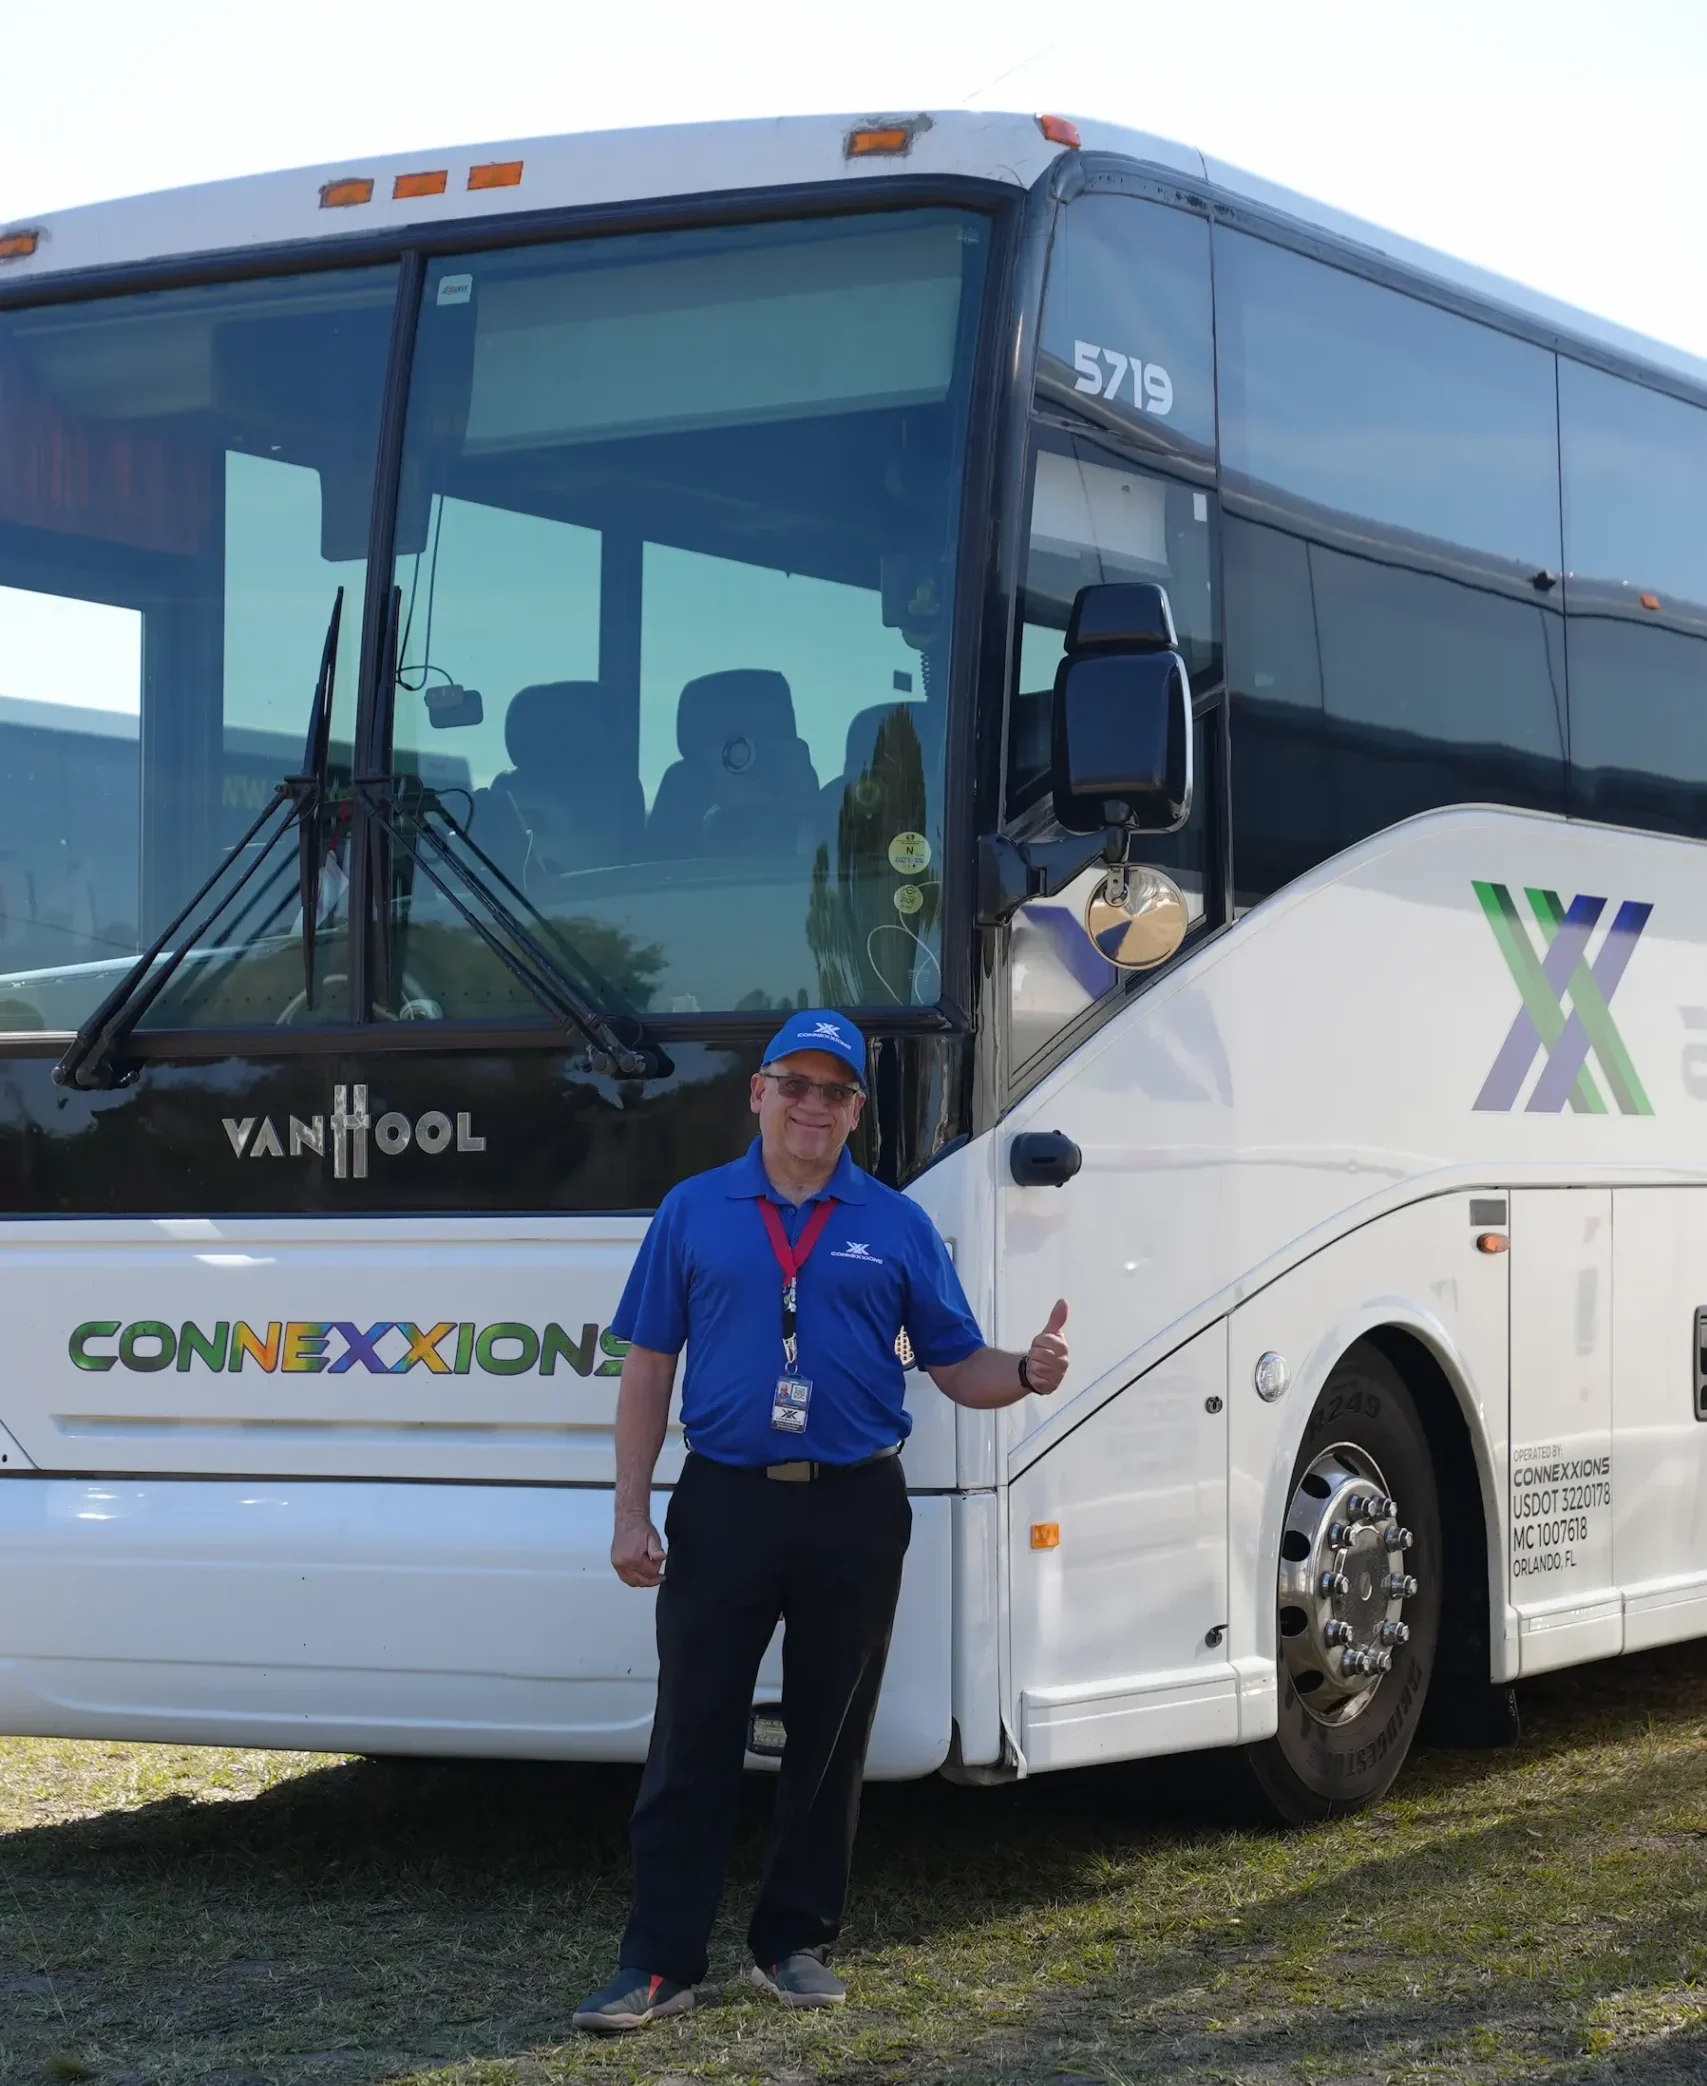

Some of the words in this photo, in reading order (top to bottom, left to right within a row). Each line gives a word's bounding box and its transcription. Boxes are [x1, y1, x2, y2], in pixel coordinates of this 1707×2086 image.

[1074, 340, 1173, 415] 5719
[797, 1033, 852, 1050] CONNEXXIONS
[1513, 1446, 1551, 1463] OPERATED
[1513, 1457, 1610, 1487] CONNEXXIONS
[1513, 1489, 1559, 1520] USDOT
[1562, 1481, 1611, 1511] 3220178
[1513, 1525, 1534, 1552] MC
[1537, 1516, 1588, 1547] 1007618
[1513, 1552, 1564, 1577] ORLANDO,
